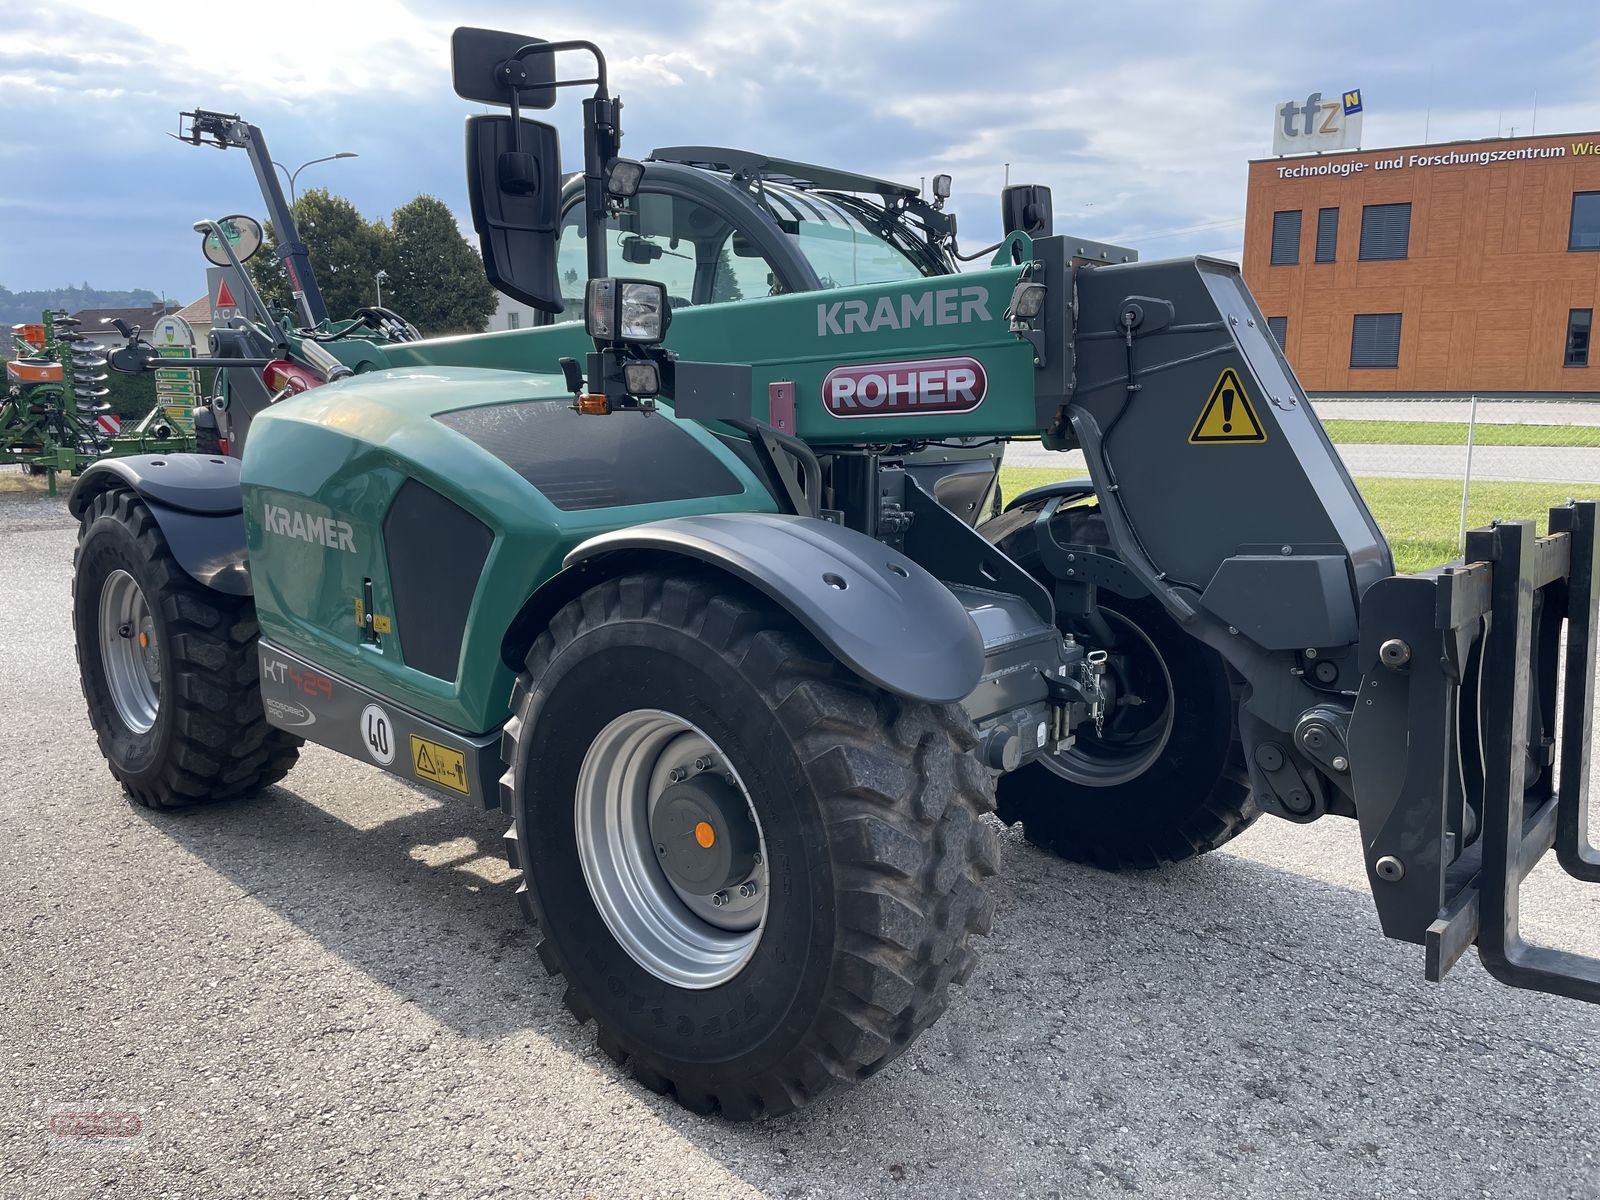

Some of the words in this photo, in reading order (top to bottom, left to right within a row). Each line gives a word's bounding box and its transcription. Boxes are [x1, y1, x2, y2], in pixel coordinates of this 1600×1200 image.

[1280, 92, 1341, 137] tfz
[1277, 160, 1369, 178] Technologie-
[1374, 156, 1403, 170] und
[1408, 146, 1566, 167] Forschungszentrum
[817, 286, 993, 336] KRAMER
[831, 368, 976, 409] ROHER
[264, 503, 357, 553] KRAMER
[368, 713, 389, 756] 40
